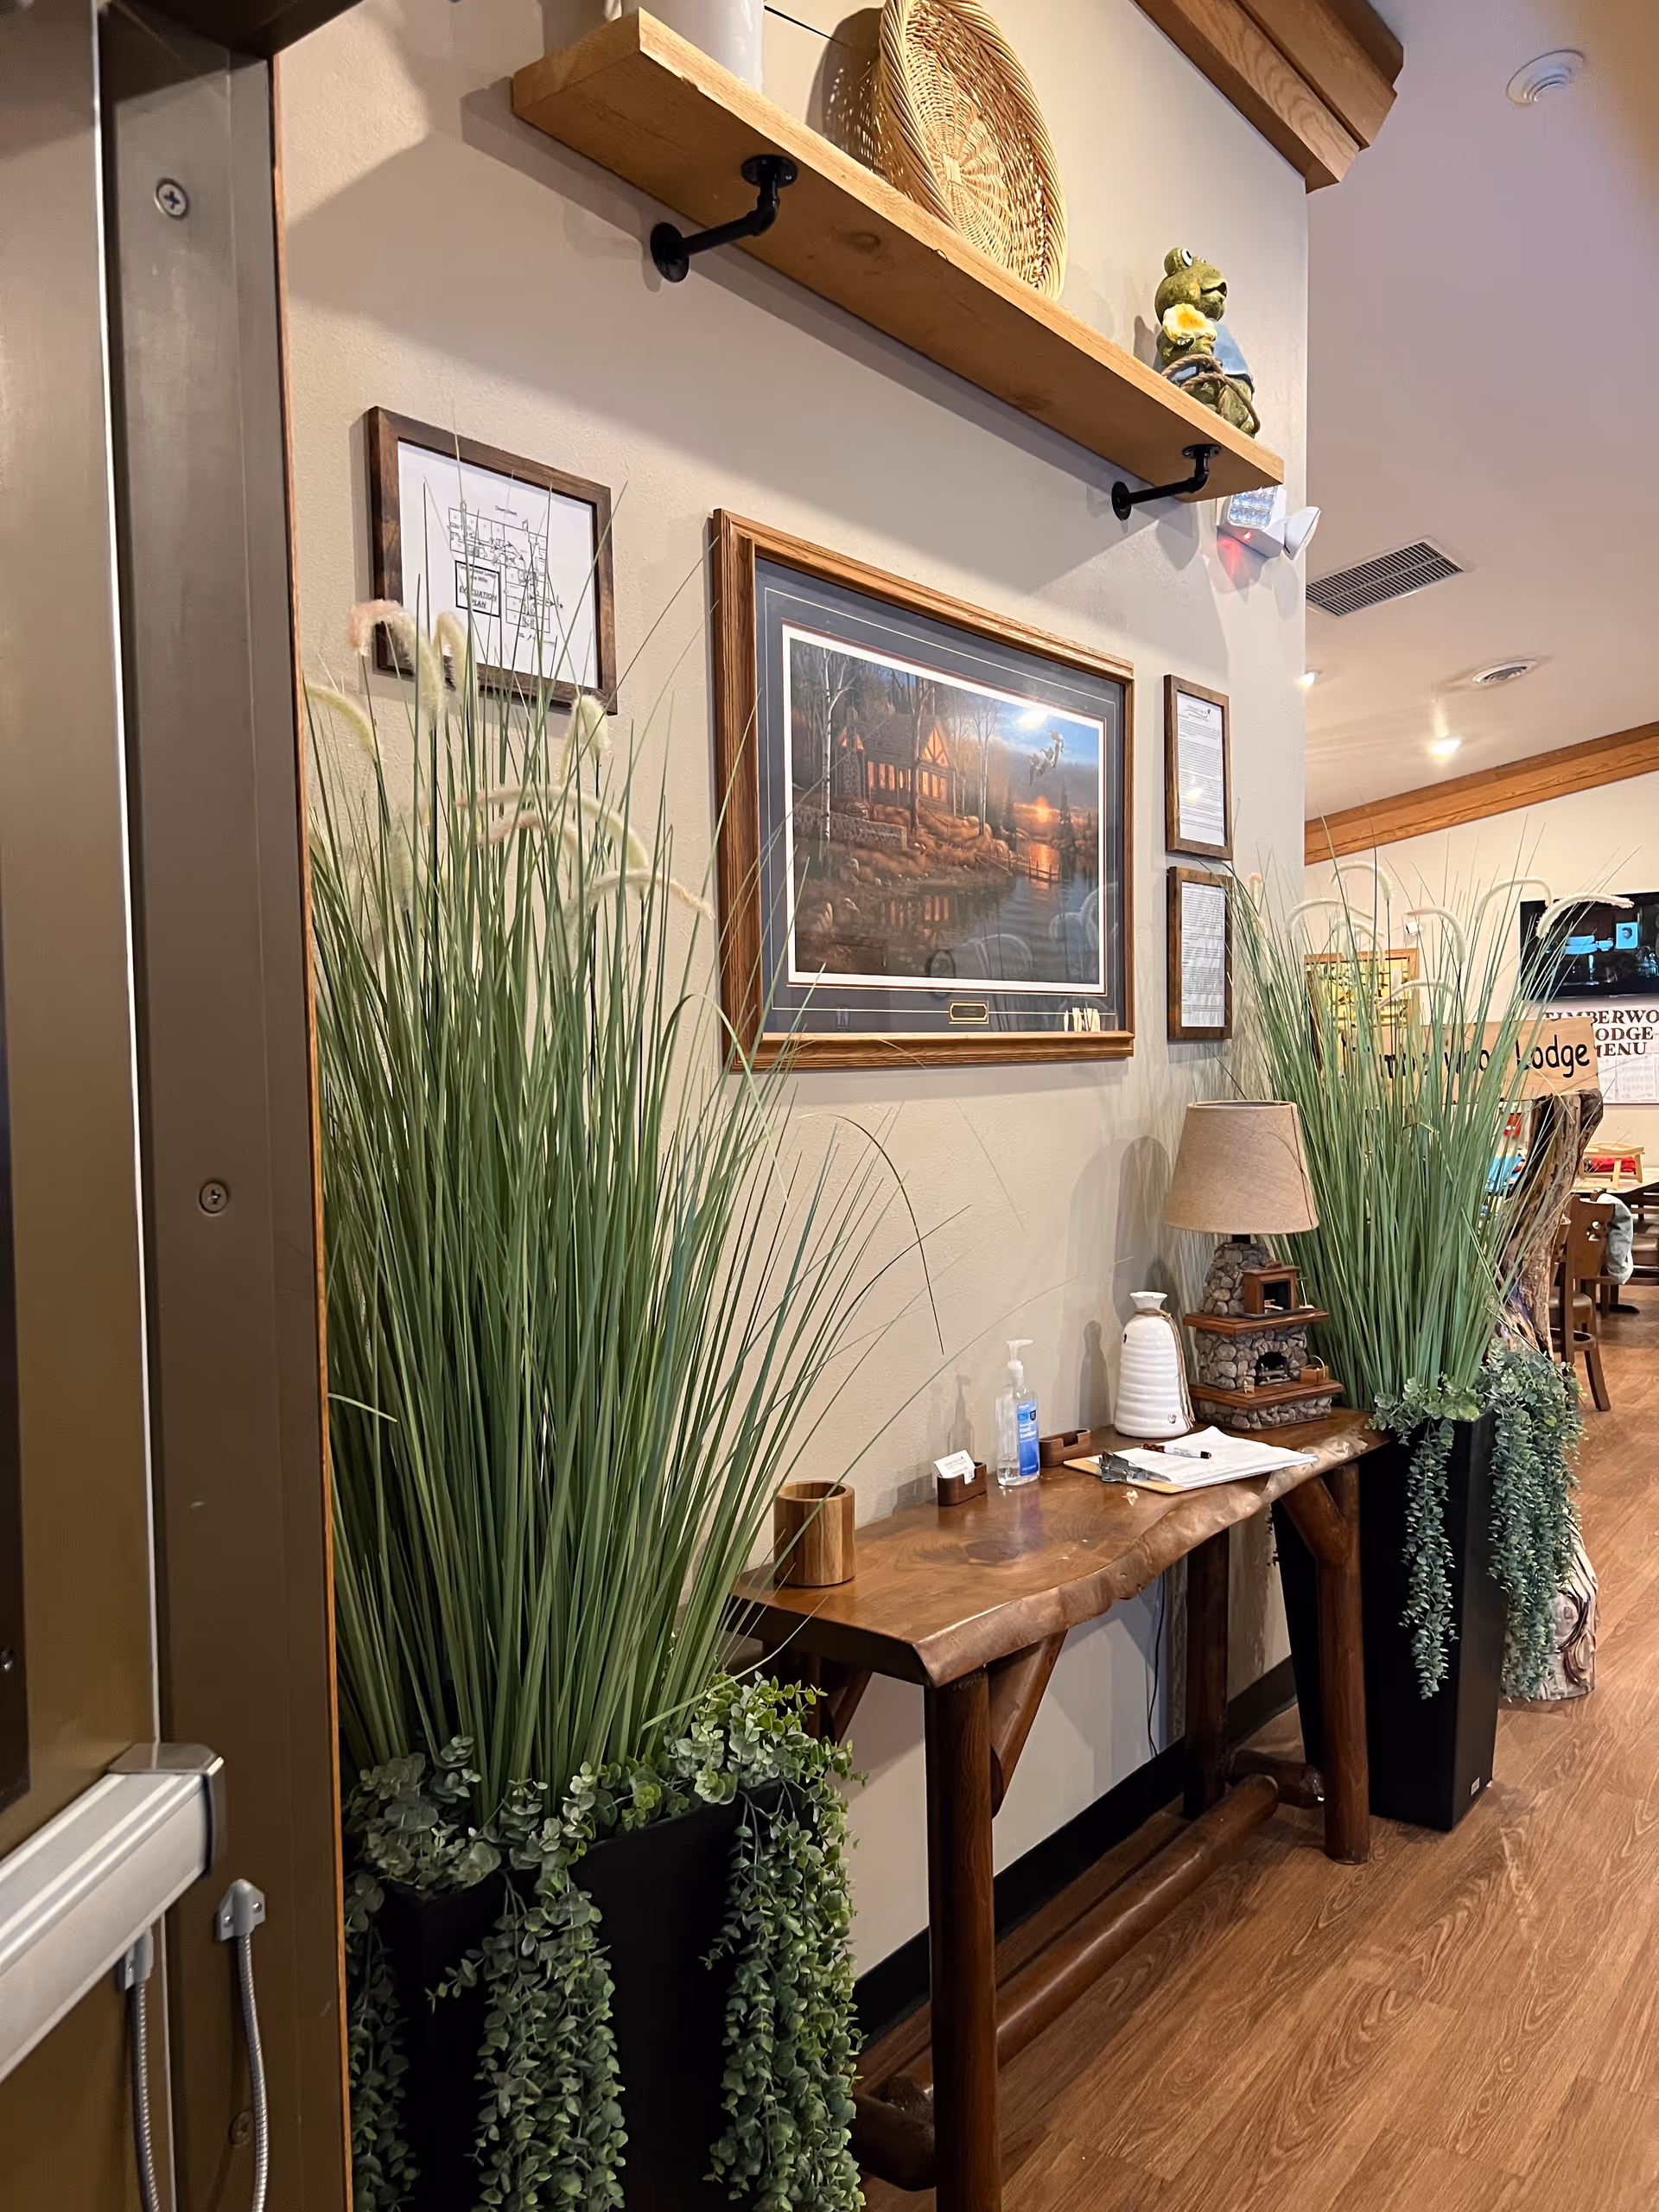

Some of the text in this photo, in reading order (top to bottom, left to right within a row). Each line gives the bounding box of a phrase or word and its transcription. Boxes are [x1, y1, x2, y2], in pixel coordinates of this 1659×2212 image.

[459, 585, 498, 601] EVCUATION
[1595, 1027, 1654, 1041] ODGE
[1516, 1034, 1590, 1078] Lodge
